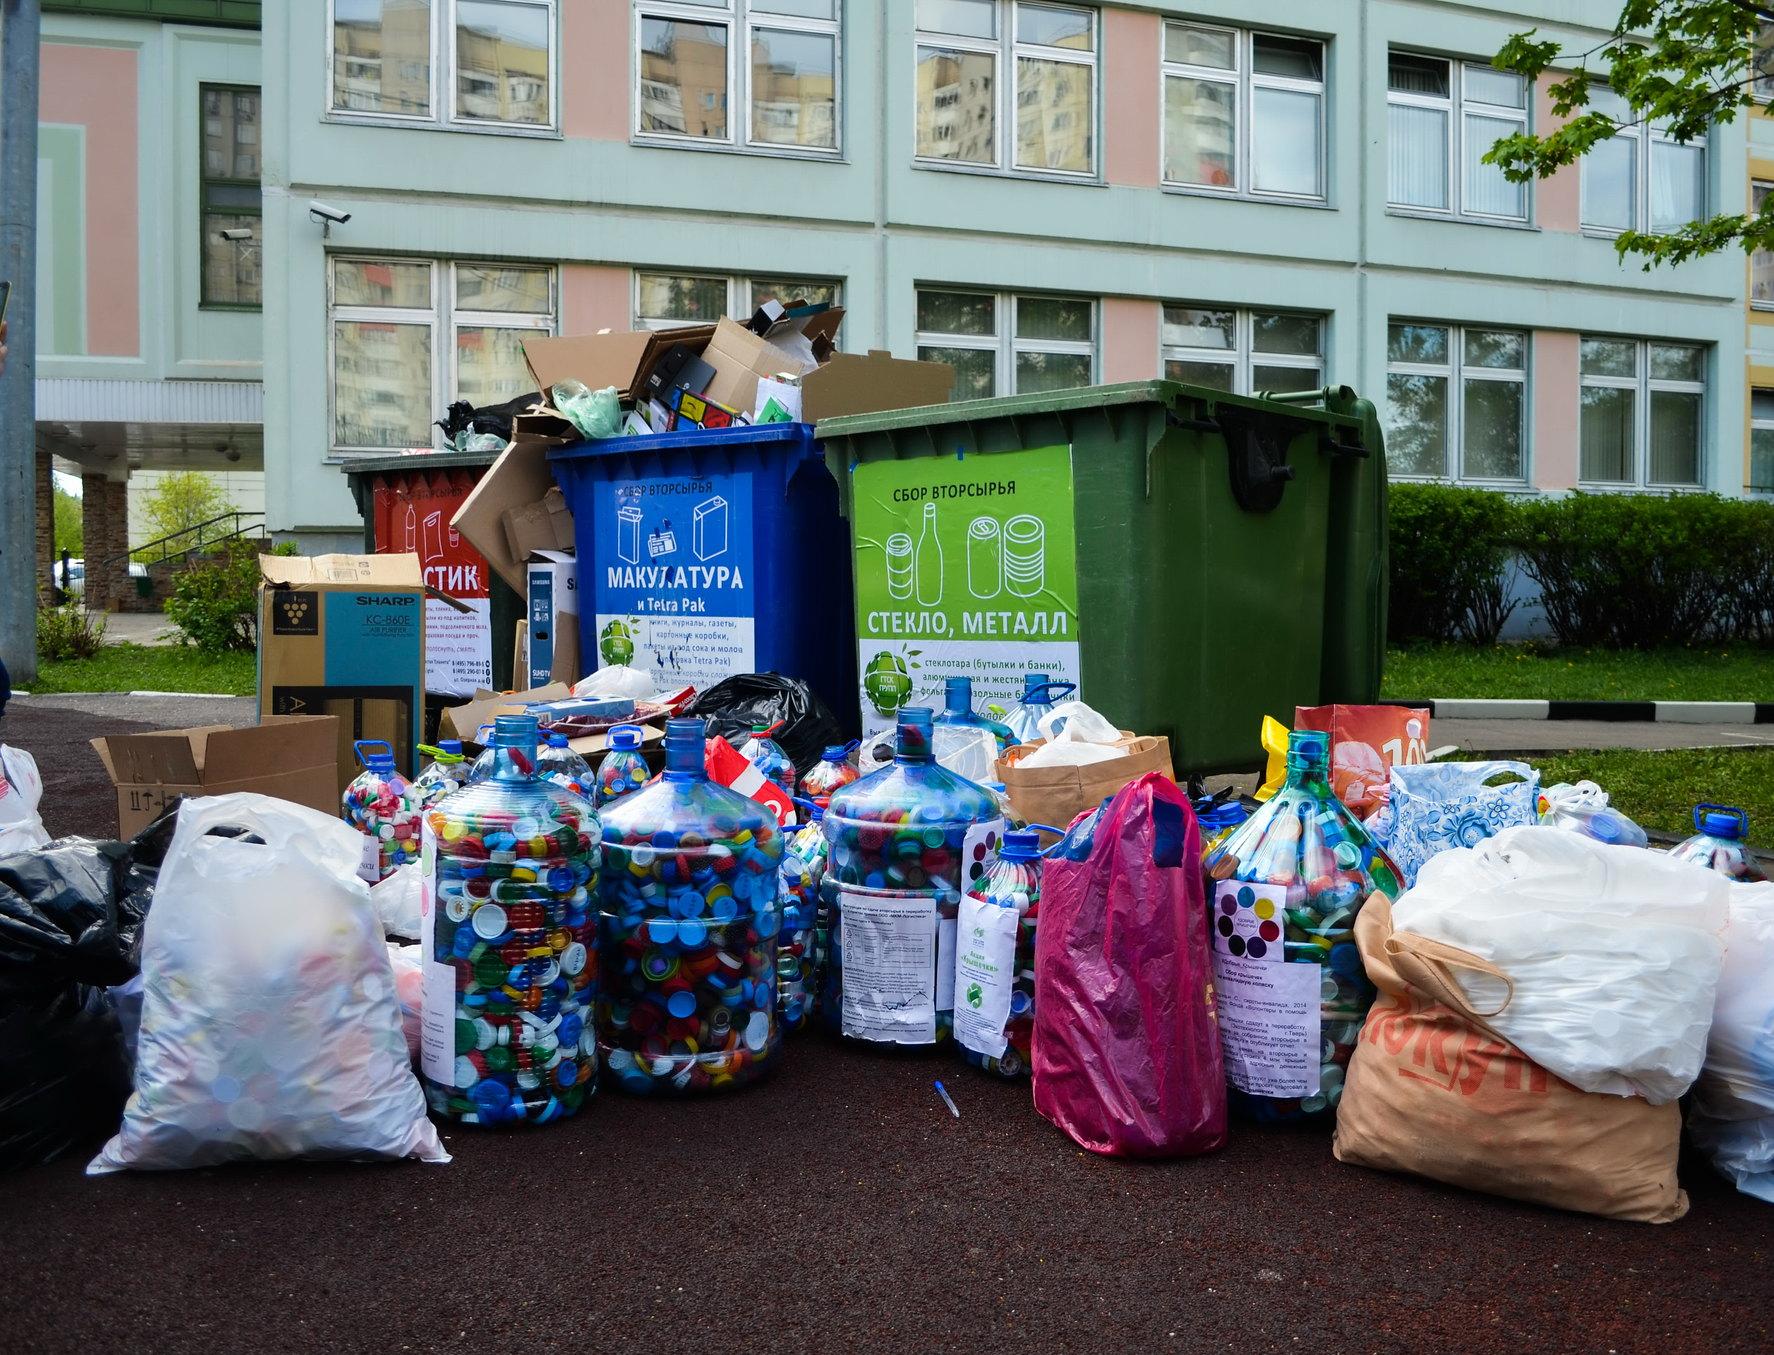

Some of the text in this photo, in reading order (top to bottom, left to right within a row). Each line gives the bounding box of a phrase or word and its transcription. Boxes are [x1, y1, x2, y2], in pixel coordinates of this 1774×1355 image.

[649, 481, 713, 496] ВТОРСЫРЬЯ
[893, 480, 1017, 502] СБОР ВТОРСЫРЬЯ
[422, 565, 479, 592] СТИК
[607, 565, 744, 590] МАКУЛАТУРА
[356, 596, 416, 606] SHARP
[637, 597, 706, 612] и Tetra Pak
[366, 614, 411, 625] KC-860E
[867, 611, 1068, 638] СТЕКЛО, МЕТАЛЛ
[695, 631, 729, 641] коробки,
[924, 658, 1066, 672] стеклотара (бутылки и банки),
